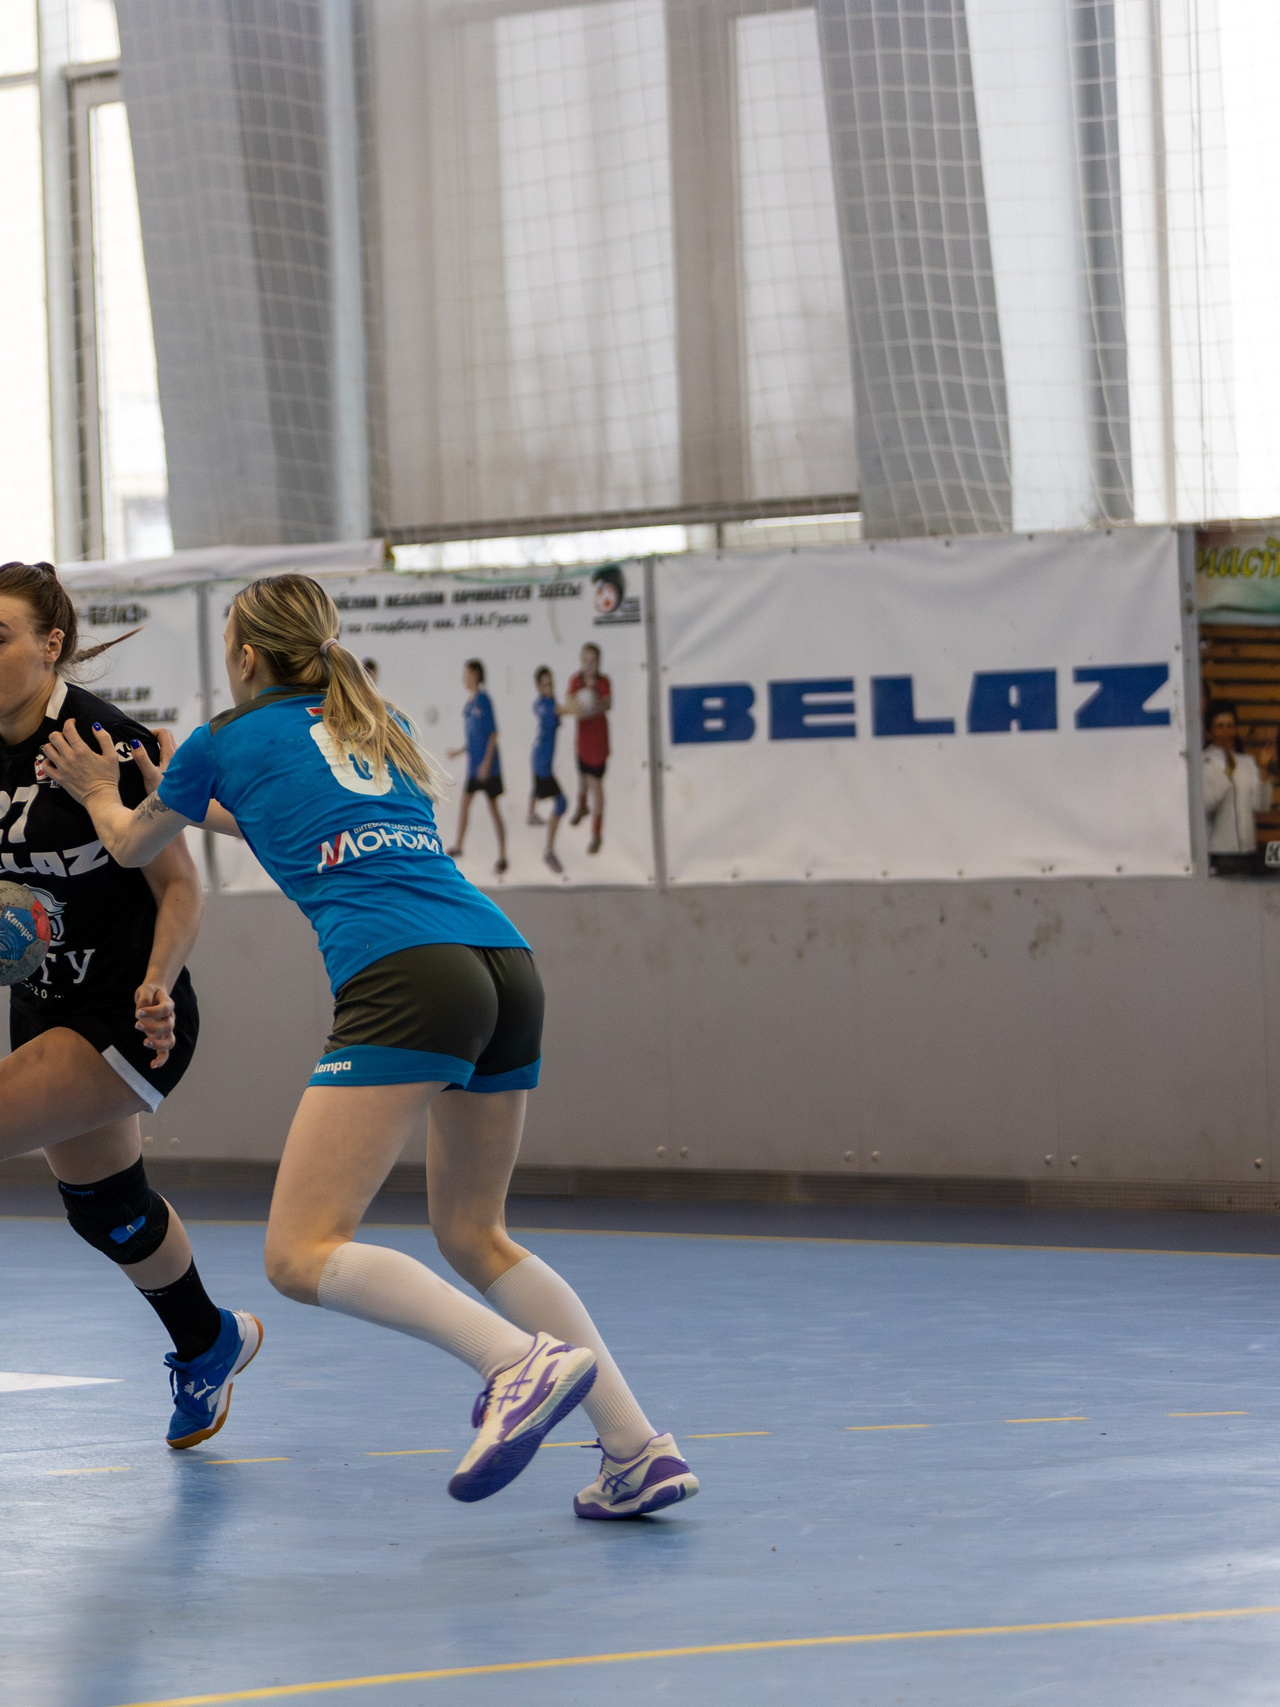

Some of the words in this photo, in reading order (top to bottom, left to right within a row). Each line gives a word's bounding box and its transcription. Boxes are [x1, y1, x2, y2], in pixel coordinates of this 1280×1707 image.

[669, 662, 1172, 745] BELAZ
[4, 910, 34, 942] Kempa
[40, 949, 96, 984] ТУ
